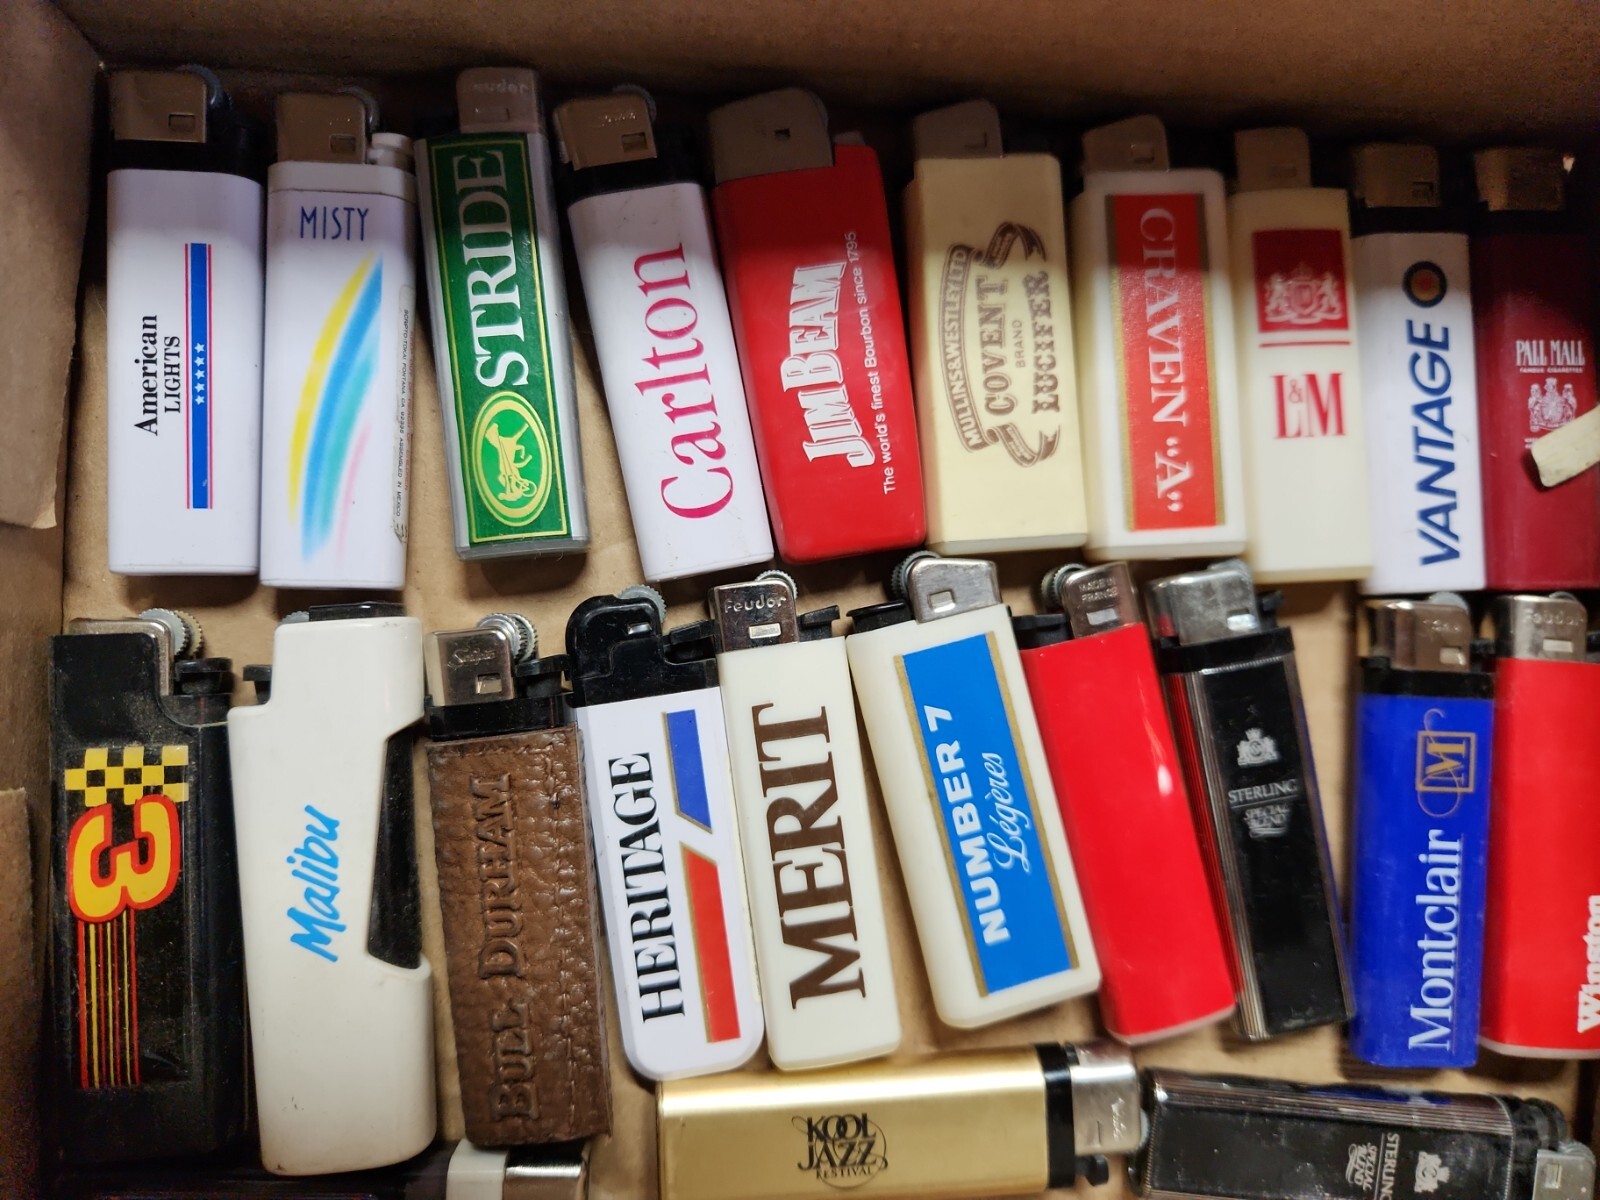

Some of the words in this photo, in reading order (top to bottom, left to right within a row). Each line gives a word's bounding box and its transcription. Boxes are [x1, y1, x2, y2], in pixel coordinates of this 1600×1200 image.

[299, 206, 370, 242] MISTY
[843, 231, 860, 264] 1795
[453, 149, 529, 389] STRIDE
[851, 268, 866, 305] since
[779, 261, 847, 392] BEAM
[857, 309, 877, 368] Bourbon
[975, 274, 1018, 416] COVENT
[1012, 319, 1026, 369] BRAND
[1021, 270, 1060, 415] LUCIFER
[1140, 207, 1189, 427] CRAVEN
[1515, 339, 1548, 367] PALL
[1549, 339, 1586, 367] MALL
[134, 314, 159, 436] American
[164, 335, 181, 414] LIGHTS
[633, 242, 735, 519] Carlton
[866, 372, 884, 410] finest
[1270, 371, 1347, 440] L&M
[797, 383, 876, 468] JIM
[872, 413, 892, 464] world's
[1406, 319, 1462, 567] VANTAGE
[882, 467, 896, 495] The
[724, 593, 787, 614] Feudor
[923, 703, 955, 733] 7
[982, 751, 1032, 874] Légères
[1228, 778, 1298, 805] STERLING
[469, 772, 525, 980] DURHAM
[751, 700, 867, 1011] MERIT
[936, 738, 1012, 946] NUMBER
[282, 803, 348, 964] Malibu
[609, 751, 687, 1024] HERITAGE
[1408, 829, 1462, 1052] Montclair
[486, 1002, 540, 1122] BULL
[797, 1139, 878, 1171] JAZZ
[806, 1111, 878, 1143] KOOL
[815, 1166, 872, 1180] FESTIVAL
